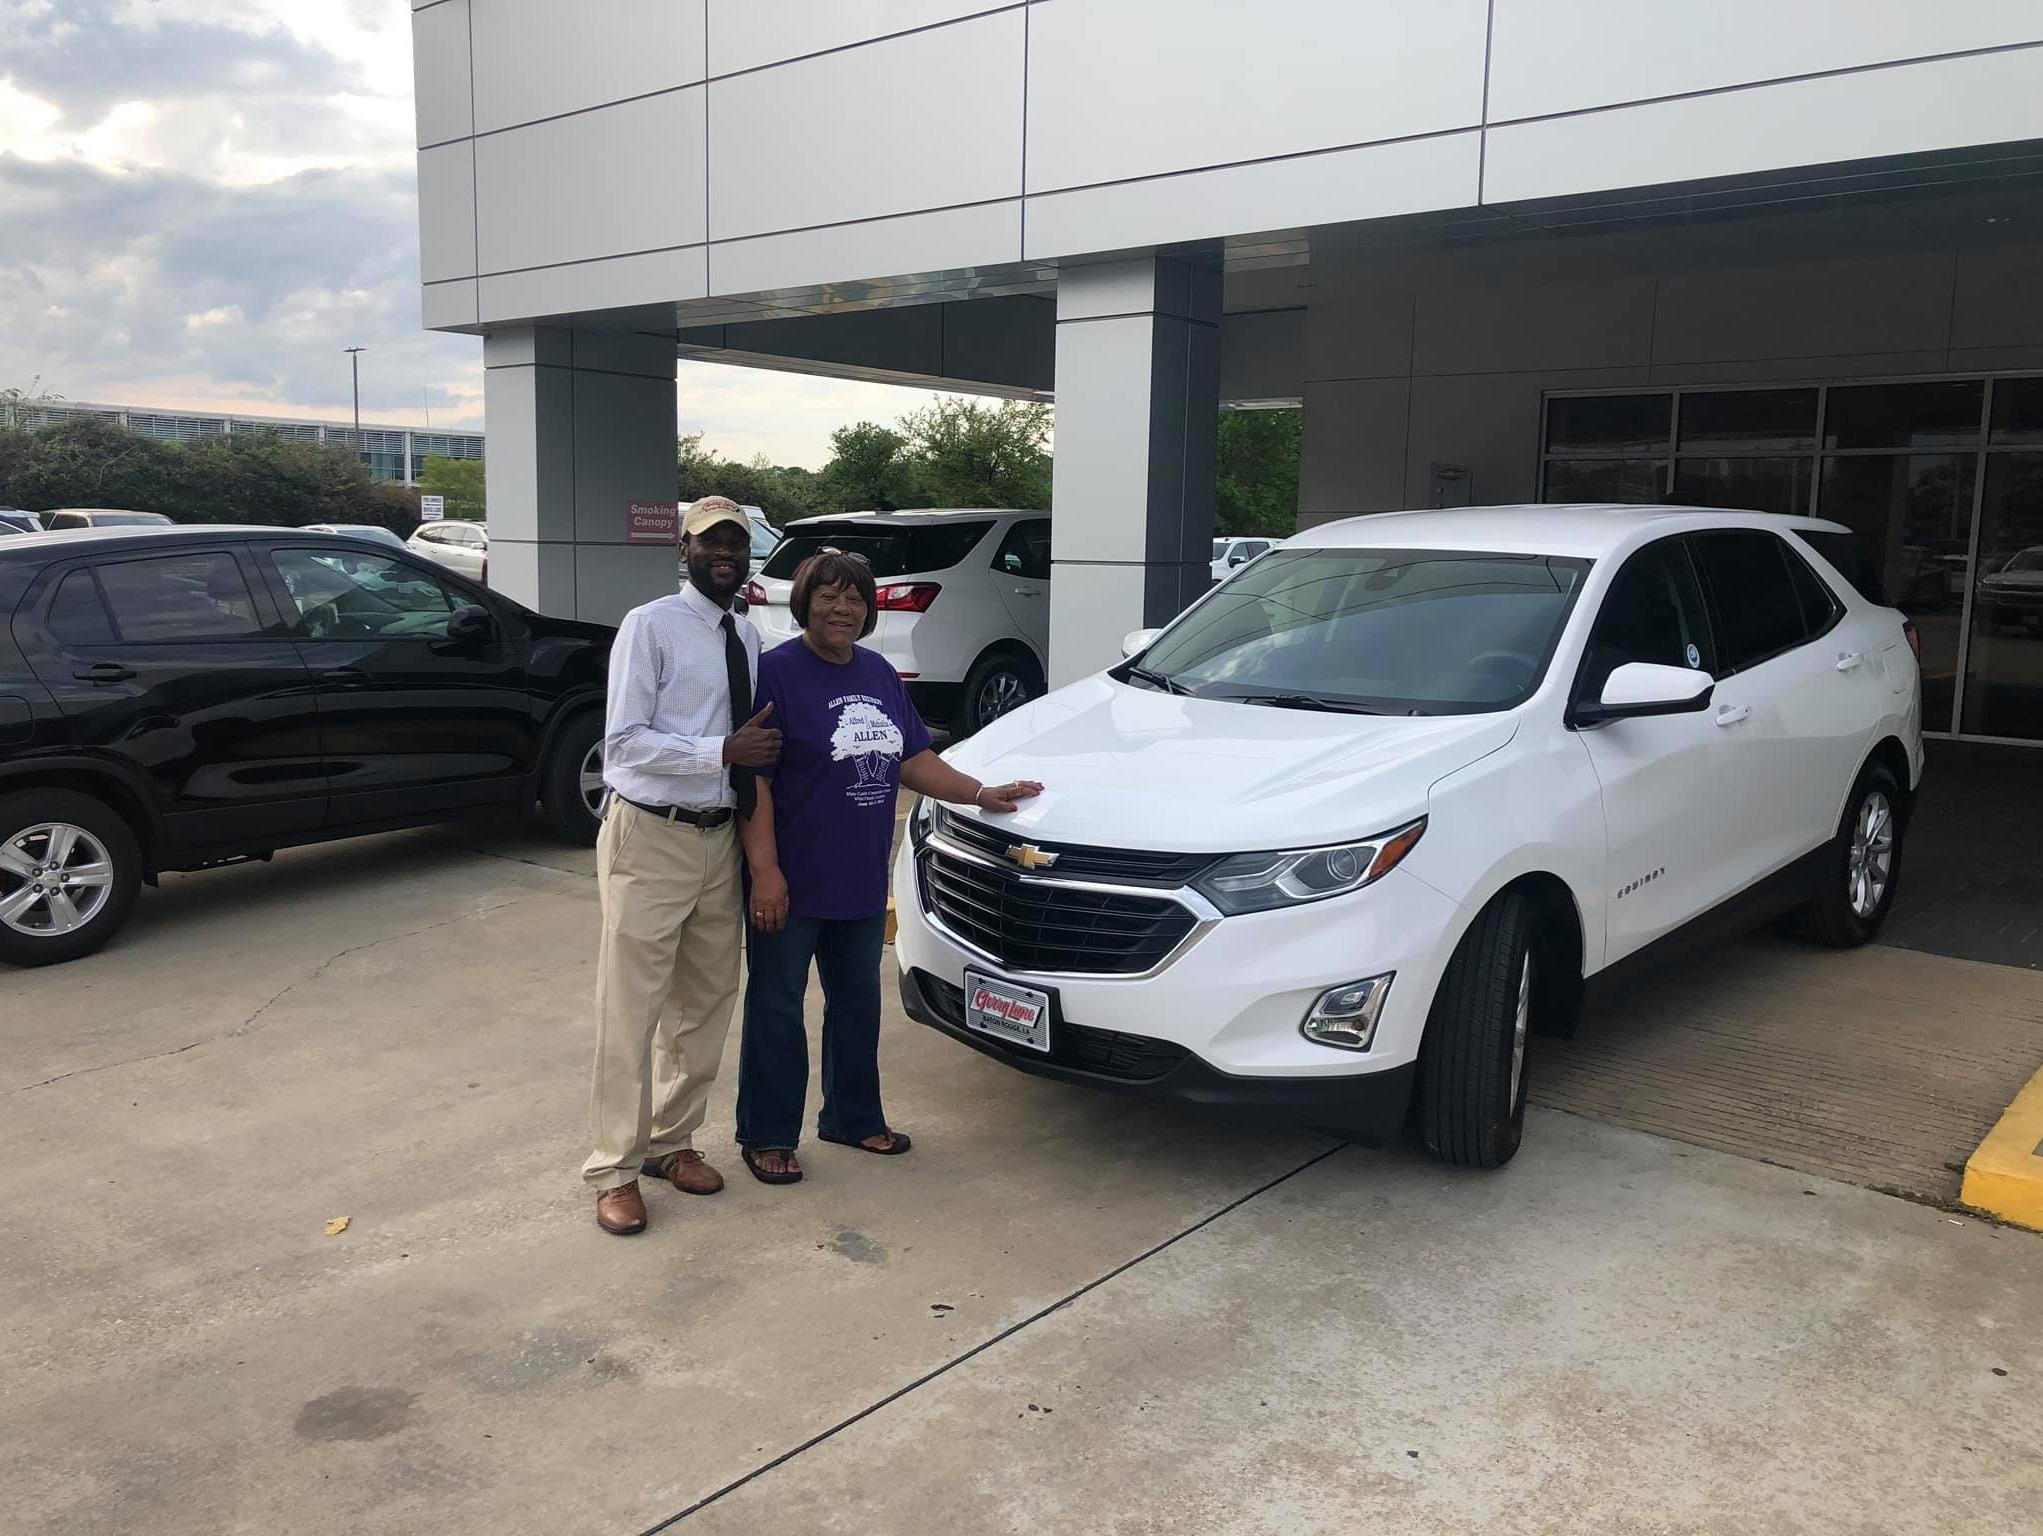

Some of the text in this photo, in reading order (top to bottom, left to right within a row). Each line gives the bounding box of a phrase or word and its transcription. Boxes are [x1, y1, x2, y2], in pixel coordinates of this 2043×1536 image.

[631, 504, 676, 517] Smoking
[634, 516, 674, 529] Canopy
[853, 730, 888, 742] ALLEN
[1617, 866, 1665, 899] EQUINOX
